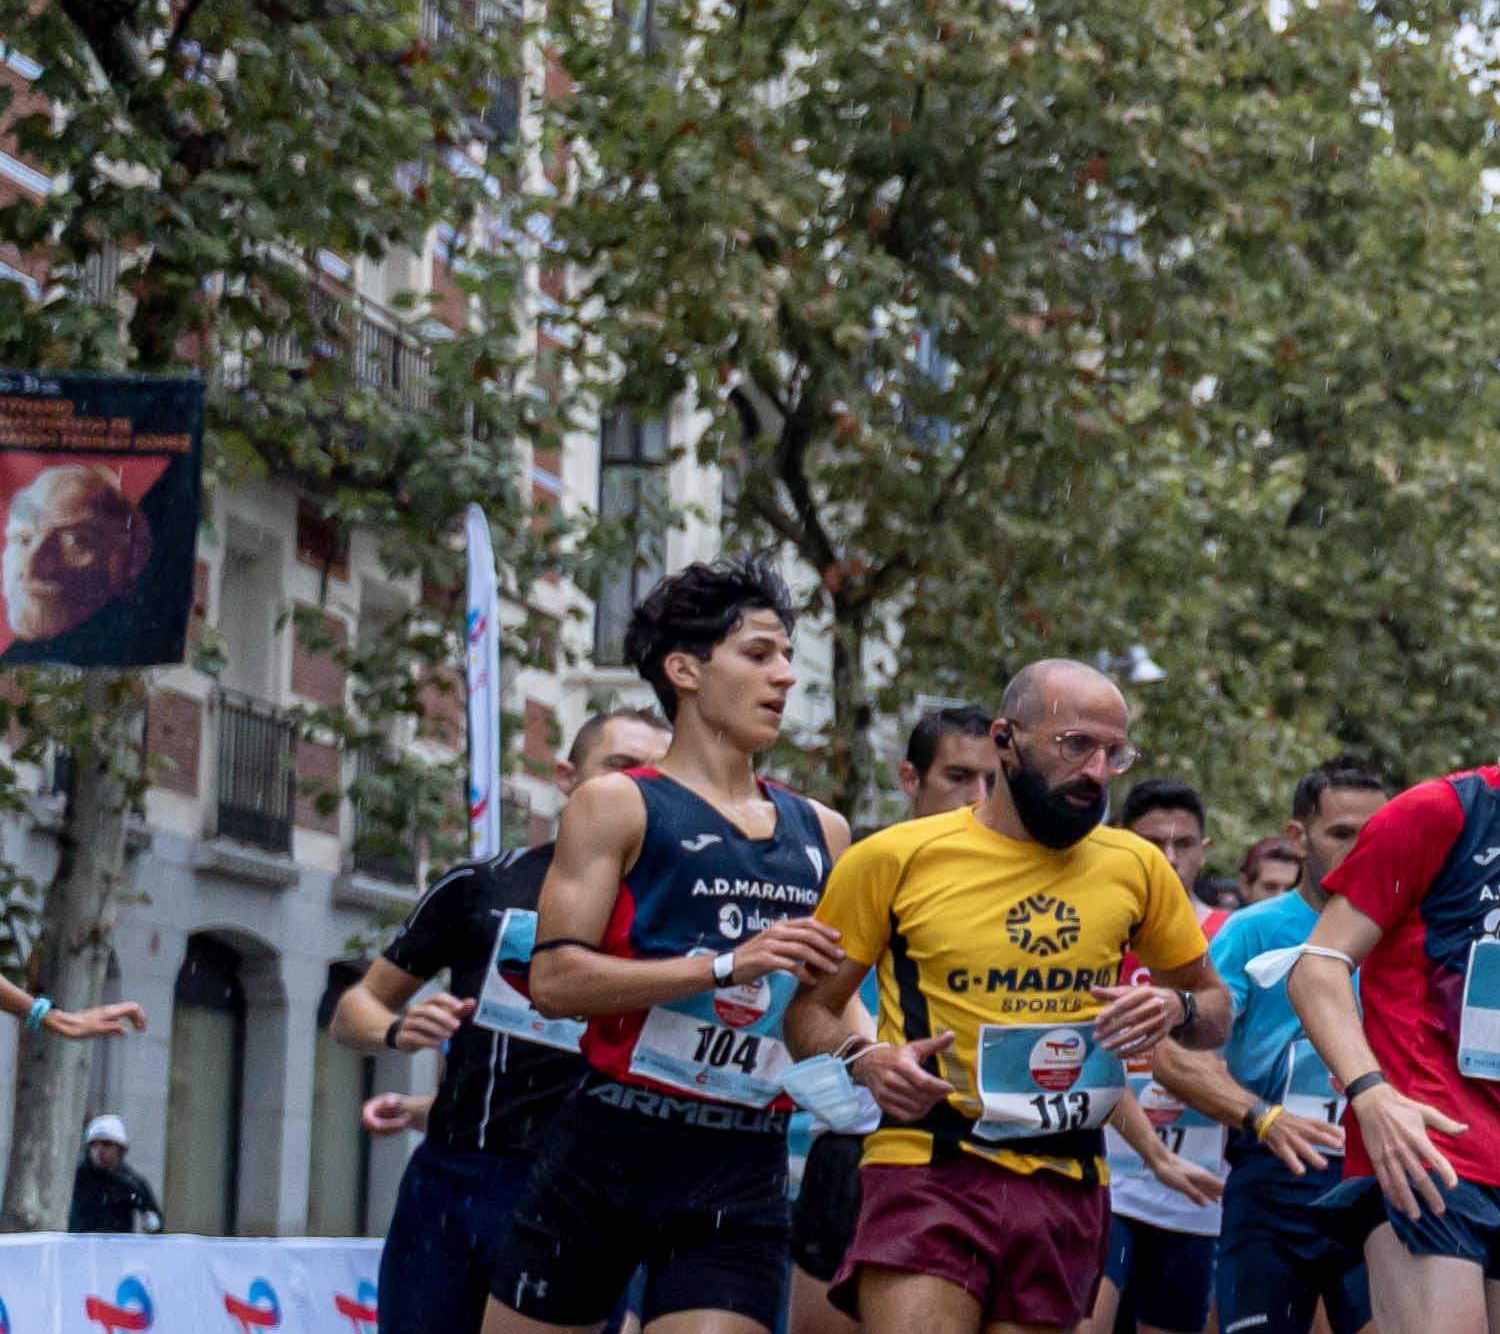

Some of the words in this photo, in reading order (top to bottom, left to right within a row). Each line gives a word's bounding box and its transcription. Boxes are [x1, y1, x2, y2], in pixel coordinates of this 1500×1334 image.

[1001, 997, 1083, 1014] SPORTS
[694, 1025, 763, 1075] 104
[585, 1080, 785, 1134] ARMOUR
[1030, 1090, 1091, 1131] 113
